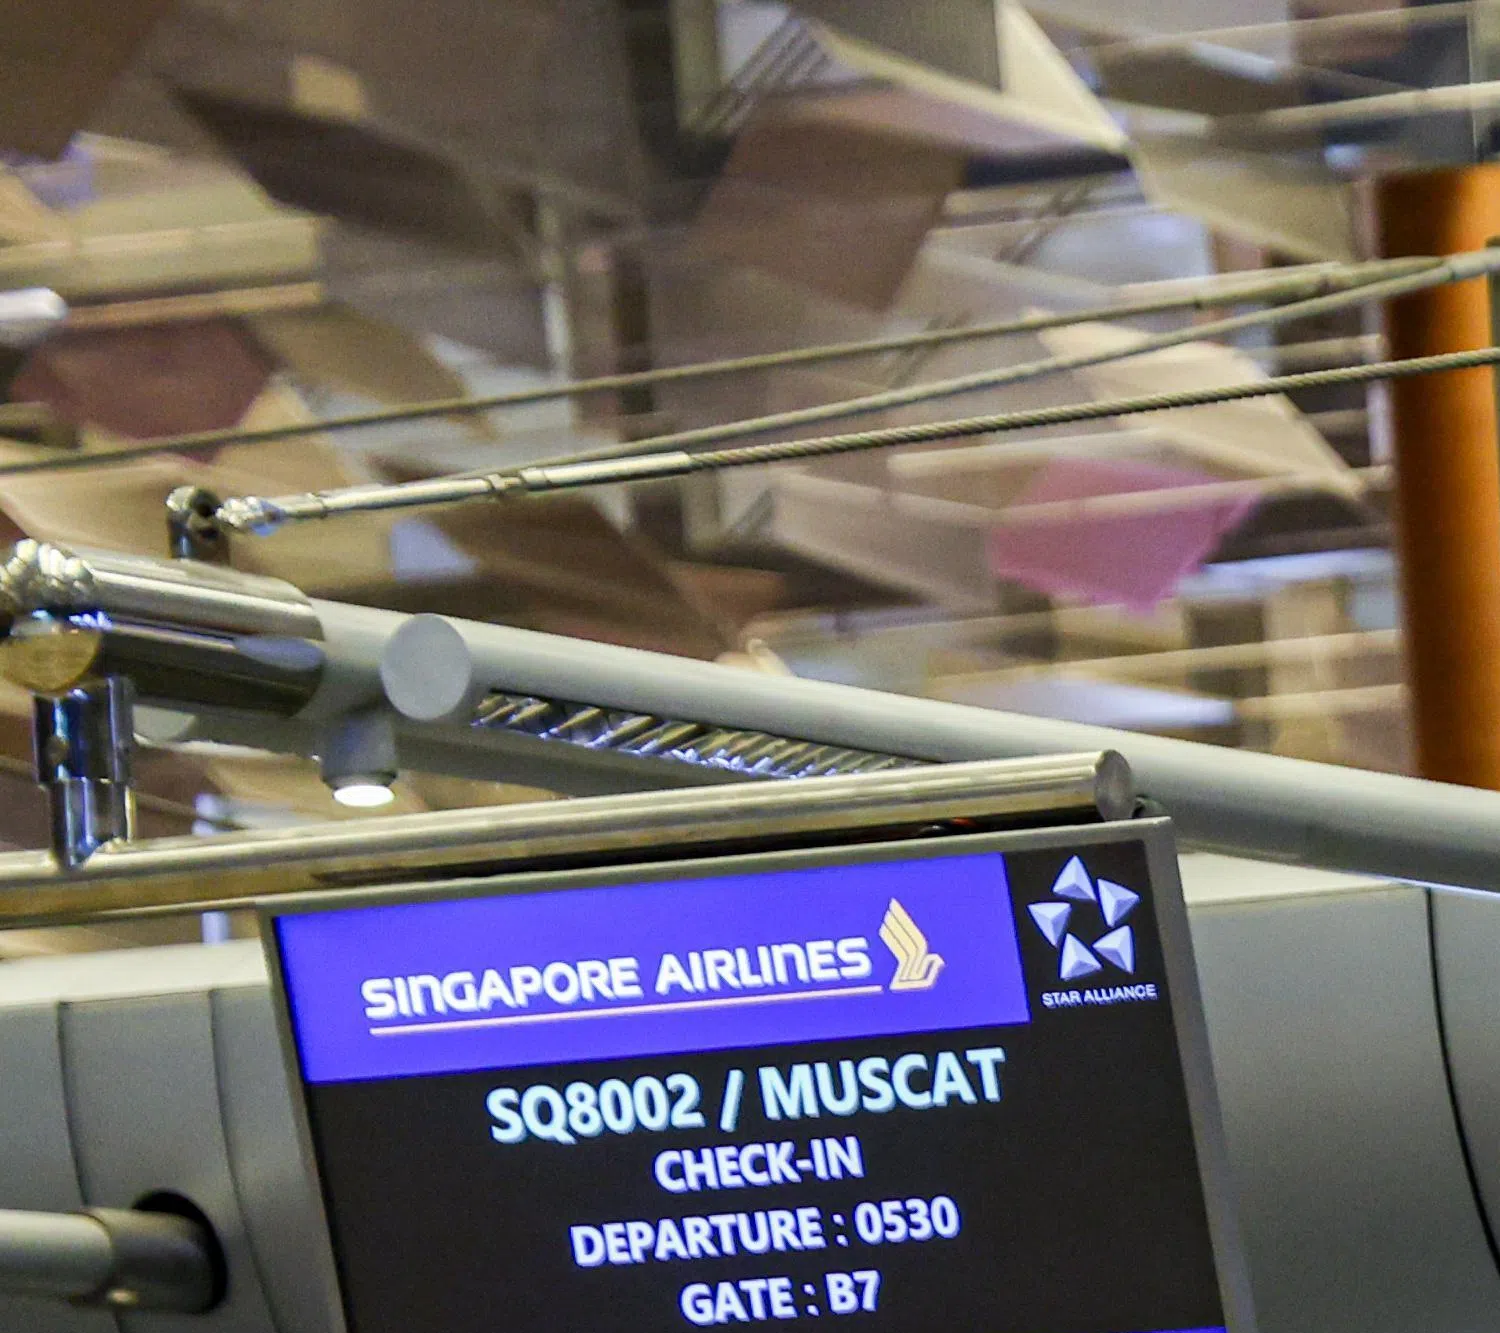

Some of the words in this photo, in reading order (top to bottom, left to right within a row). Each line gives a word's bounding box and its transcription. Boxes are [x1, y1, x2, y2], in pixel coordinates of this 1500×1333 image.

[360, 956, 643, 1019] SINGAPORE
[654, 936, 872, 995] AIRLINES
[1041, 989, 1082, 1007] STAR
[1082, 982, 1157, 1004] ALLIANCE
[485, 1072, 704, 1144] SQ8002
[719, 1068, 743, 1132] /
[757, 1046, 1005, 1121] MUSCAT
[653, 1135, 863, 1192] CHECK-IN
[569, 1206, 826, 1267] DEPARTURE
[831, 1213, 848, 1246] :
[854, 1195, 959, 1243] 0530
[680, 1276, 797, 1324] GATE
[803, 1283, 819, 1316] :
[824, 1269, 879, 1313] B7
